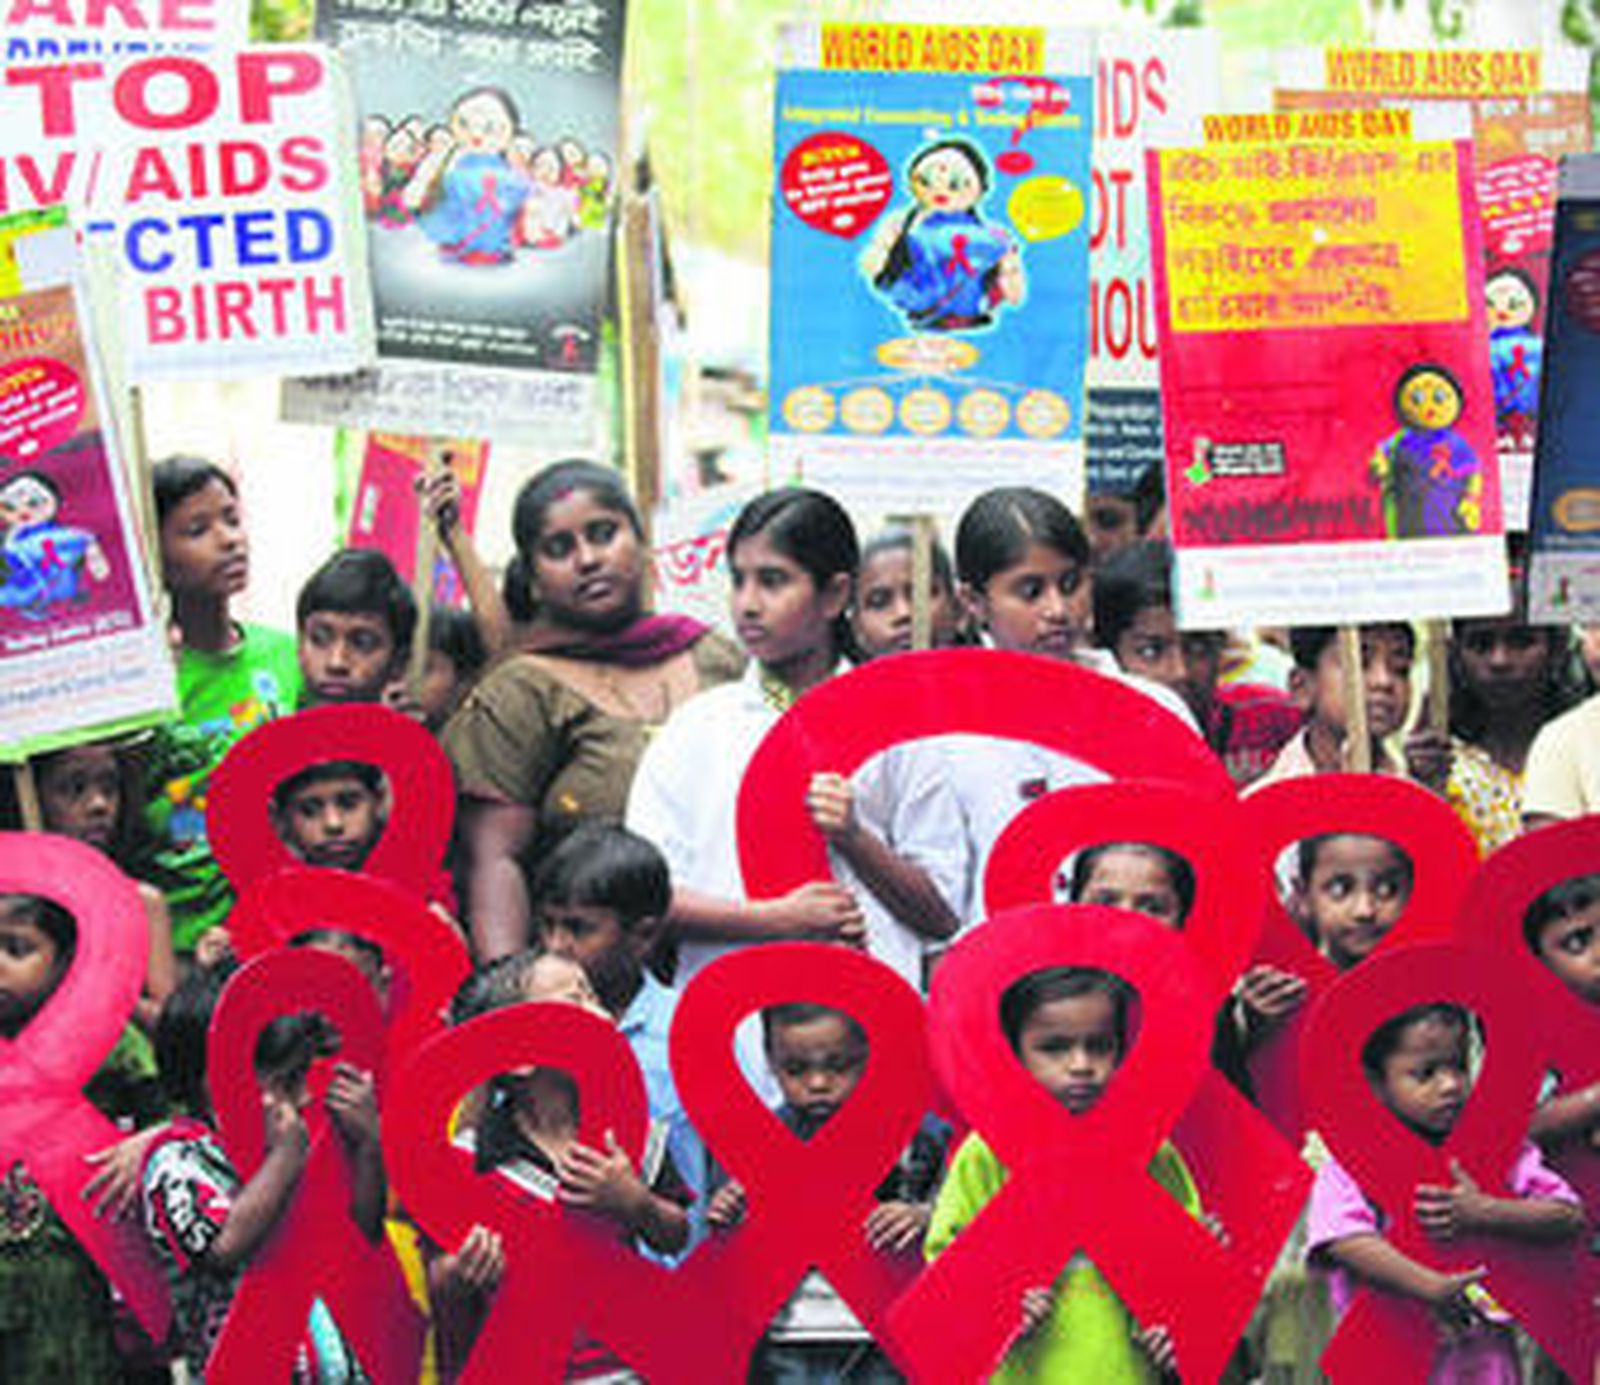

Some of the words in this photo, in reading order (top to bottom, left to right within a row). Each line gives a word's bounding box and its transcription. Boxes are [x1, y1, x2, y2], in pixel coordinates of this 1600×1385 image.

[823, 27, 914, 69] WORLD
[921, 29, 981, 70] AIDS
[987, 31, 1041, 70] DAY
[1326, 50, 1414, 89] WORLD
[1425, 51, 1483, 90] AIDS
[1489, 52, 1540, 91] DAY
[1203, 113, 1291, 142] WORLD
[1299, 112, 1356, 140] AIDS
[1362, 109, 1412, 138] DAY
[124, 136, 330, 202] AIDS
[88, 208, 334, 273] CTED
[145, 275, 346, 345] BIRTH
